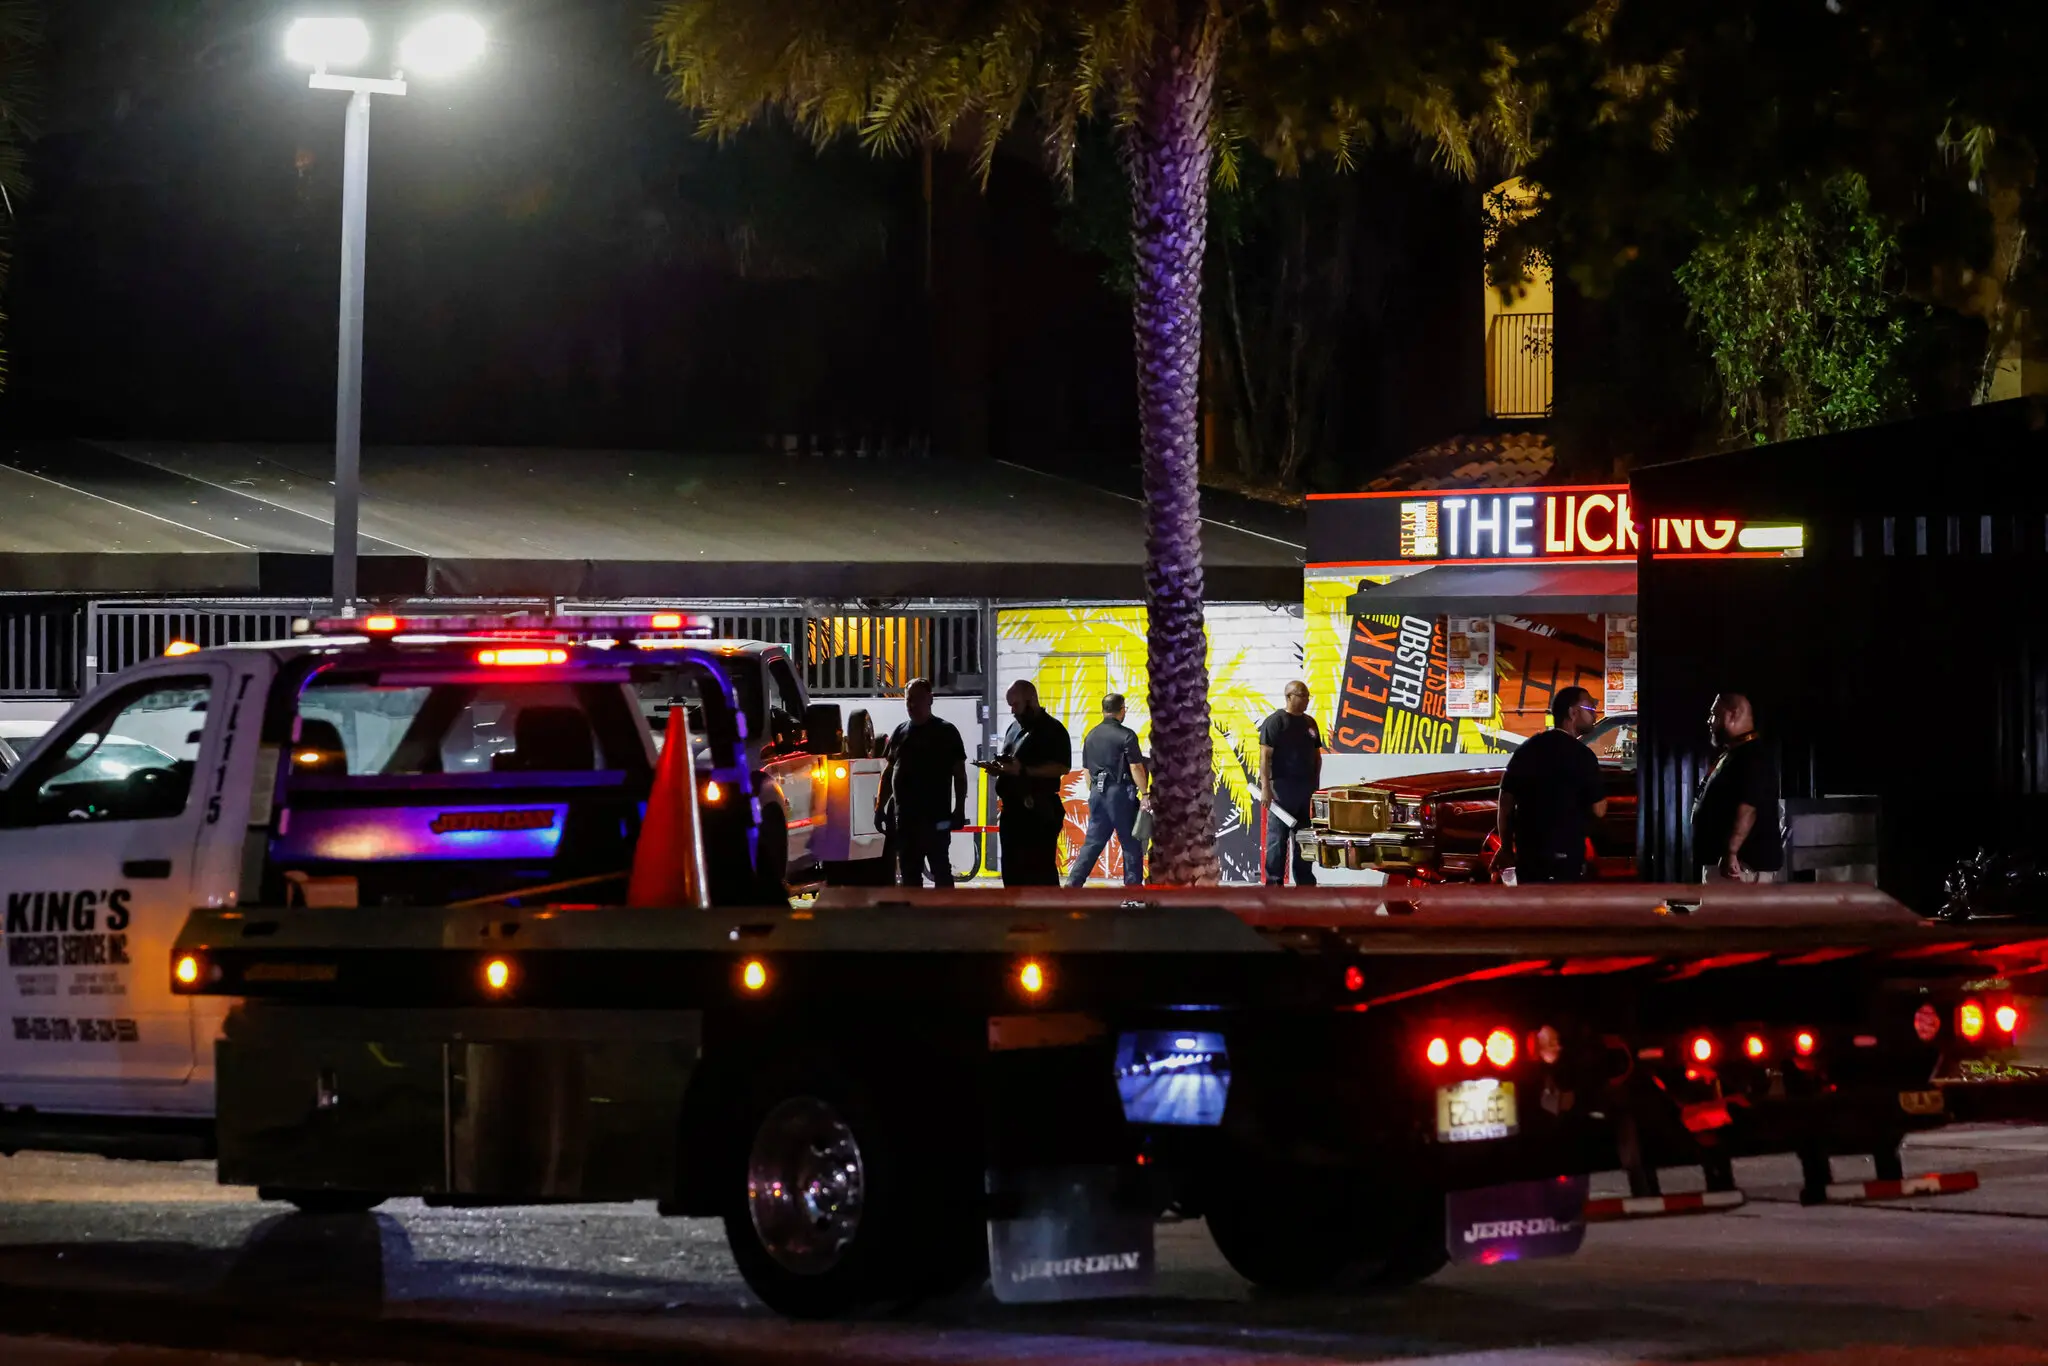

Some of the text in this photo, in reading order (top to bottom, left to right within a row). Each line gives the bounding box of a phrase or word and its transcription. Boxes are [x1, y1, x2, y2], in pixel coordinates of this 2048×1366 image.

[1401, 512, 1416, 556] STEAK
[1443, 498, 1534, 555] THE
[1338, 620, 1398, 753] STEAK
[1421, 690, 1453, 722] RIC
[1380, 706, 1453, 754] MUSIC
[6, 889, 131, 933] KING'S
